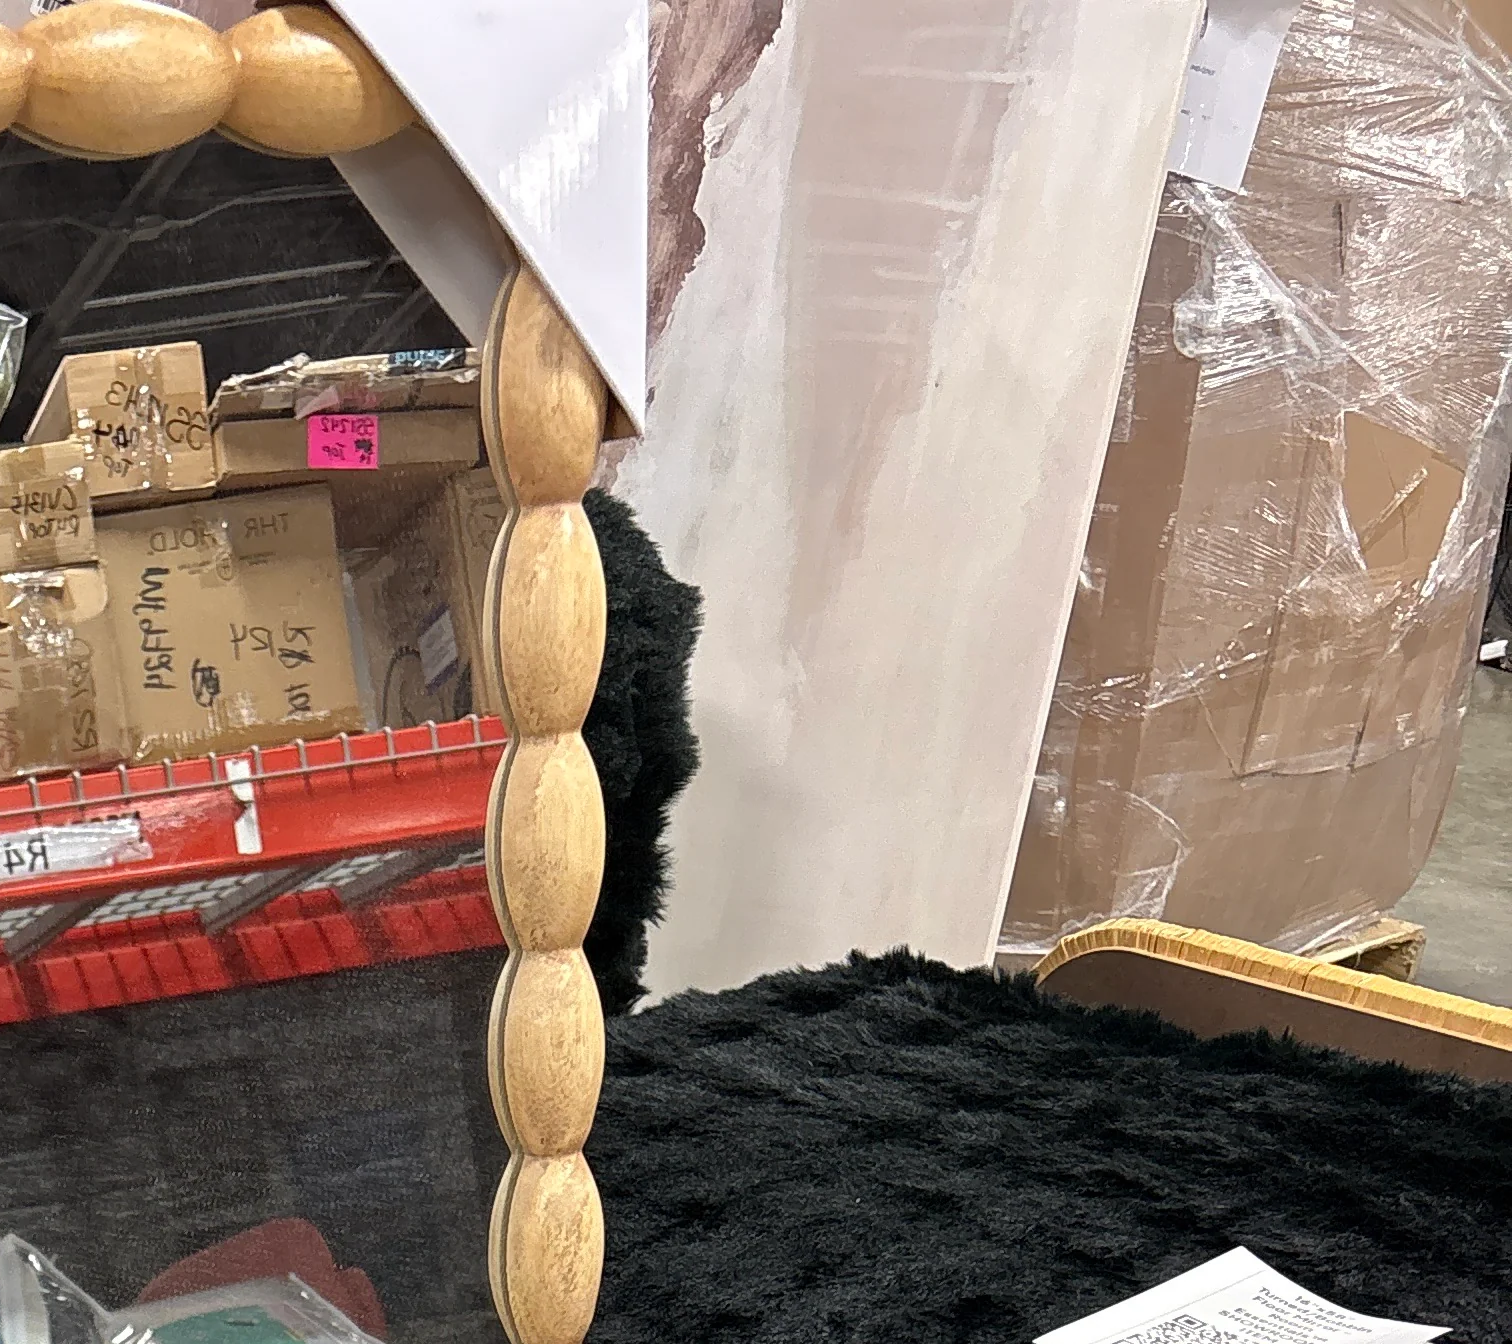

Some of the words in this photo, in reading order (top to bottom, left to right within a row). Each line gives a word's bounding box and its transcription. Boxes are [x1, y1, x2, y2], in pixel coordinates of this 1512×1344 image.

[1252, 1296, 1291, 1316] Floor
[1293, 1314, 1340, 1333] Mirror
[1239, 1327, 1280, 1344] ITEM
